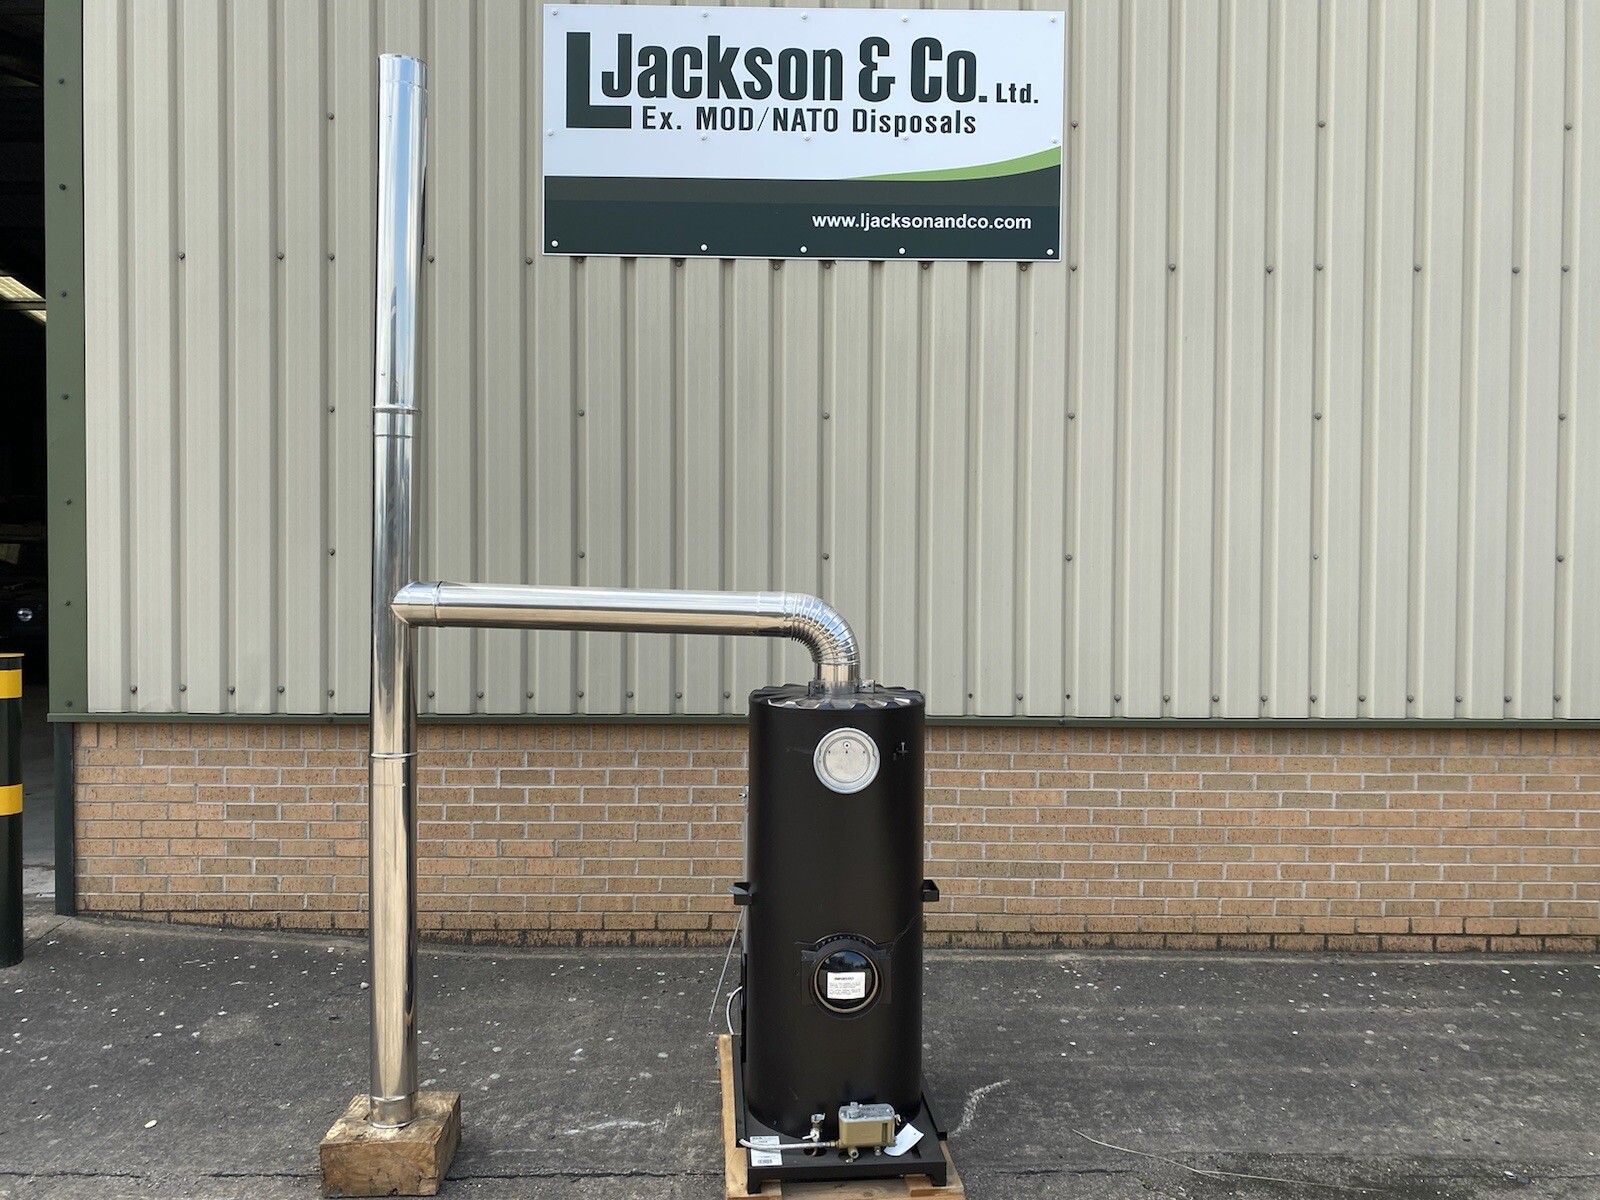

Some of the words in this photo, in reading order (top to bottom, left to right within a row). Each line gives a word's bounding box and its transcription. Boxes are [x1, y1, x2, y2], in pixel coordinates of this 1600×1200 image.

[858, 36, 896, 103] &
[910, 36, 988, 103] Co.
[996, 82, 1039, 104] Ltd.
[642, 105, 682, 130] Ex.
[696, 106, 839, 132] MOD/NATO
[852, 108, 976, 138] Disposals
[812, 212, 1032, 232] www.ljacksonandco.com
